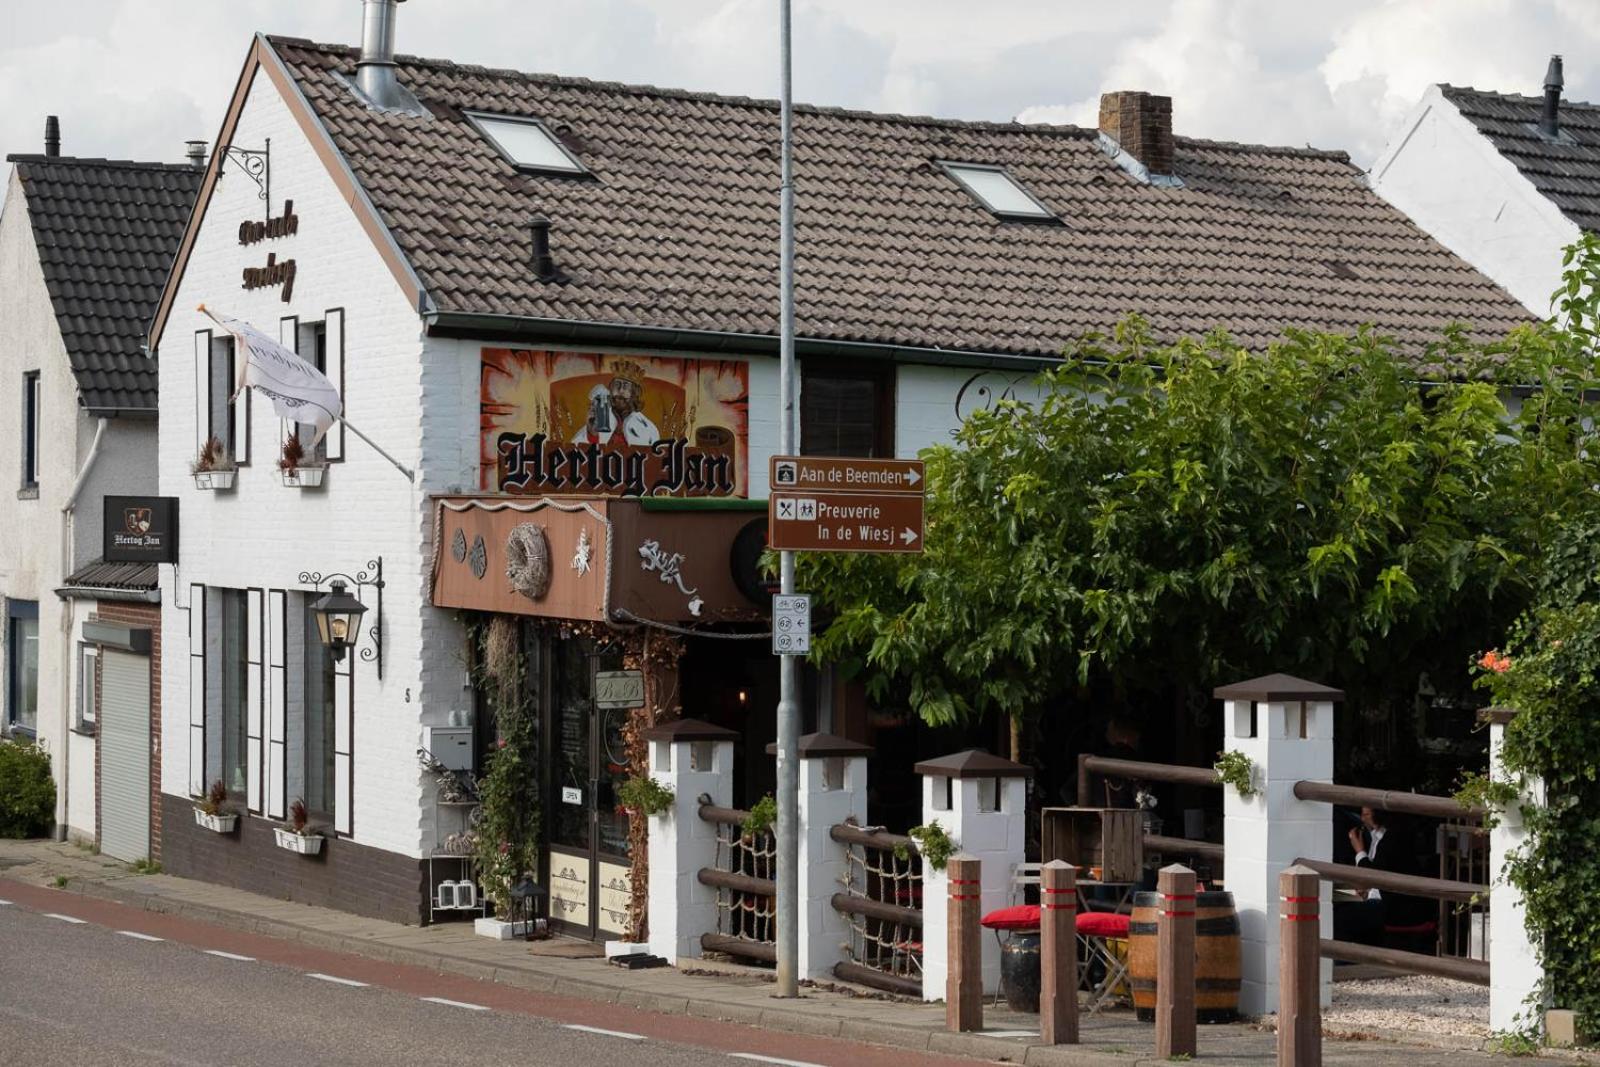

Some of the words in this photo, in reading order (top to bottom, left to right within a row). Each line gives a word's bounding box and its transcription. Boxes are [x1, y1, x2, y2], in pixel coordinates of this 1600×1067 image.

[497, 431, 648, 498] Hertog
[652, 437, 736, 498] Jan
[800, 466, 825, 482] Aan
[828, 466, 843, 483] de
[846, 467, 902, 485] Beemden
[818, 502, 881, 519] Preuverie
[113, 534, 143, 546] Hertog
[144, 535, 160, 545] Jan
[818, 524, 830, 540] In
[837, 525, 852, 540] de
[860, 525, 895, 545] Wiesj
[795, 601, 807, 609] 90
[780, 637, 791, 646] 92
